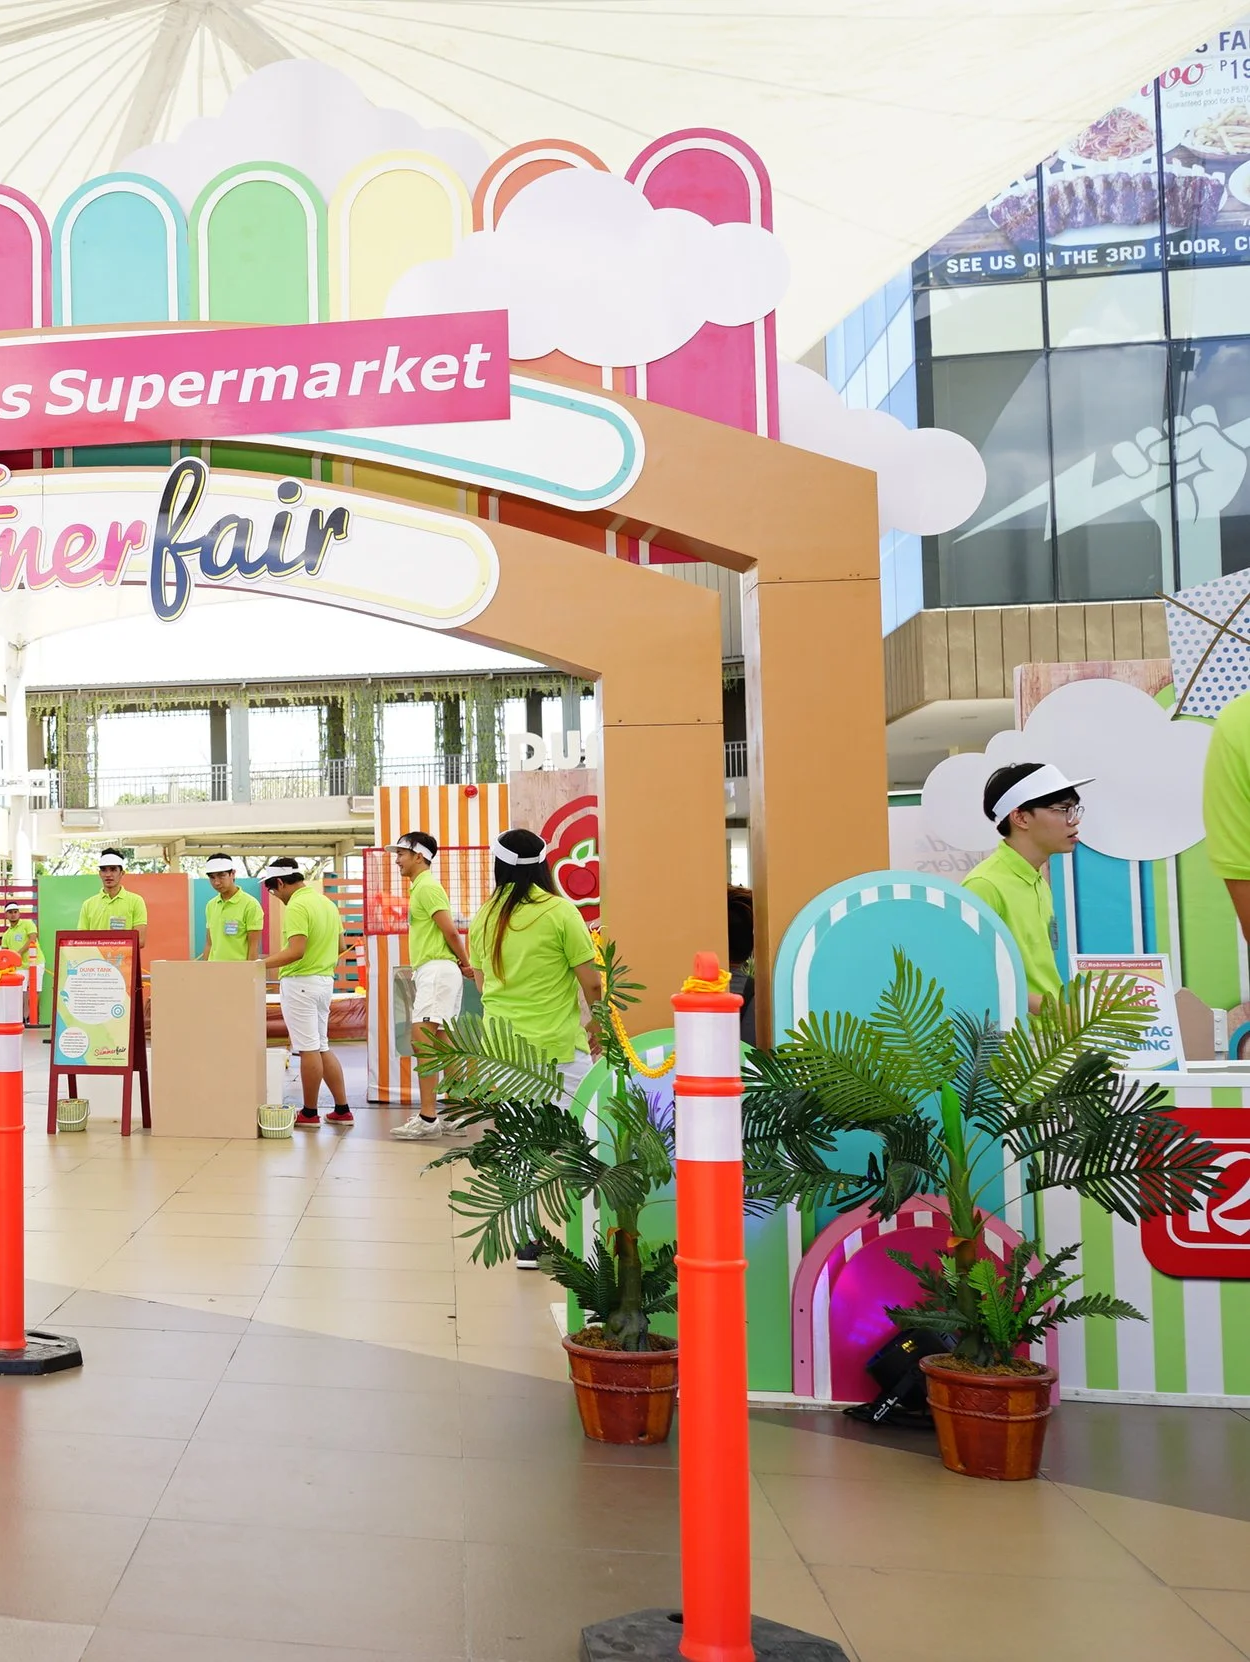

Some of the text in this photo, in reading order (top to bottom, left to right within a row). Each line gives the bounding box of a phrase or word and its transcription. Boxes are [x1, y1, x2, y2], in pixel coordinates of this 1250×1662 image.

[1218, 30, 1250, 52] FA
[946, 256, 983, 275] SEE
[989, 255, 1016, 271] US
[1023, 251, 1055, 269] ON
[1060, 249, 1099, 266] THE
[1105, 245, 1146, 263] 3RD
[1234, 236, 1250, 251] C
[44, 343, 492, 423] Supermarket
